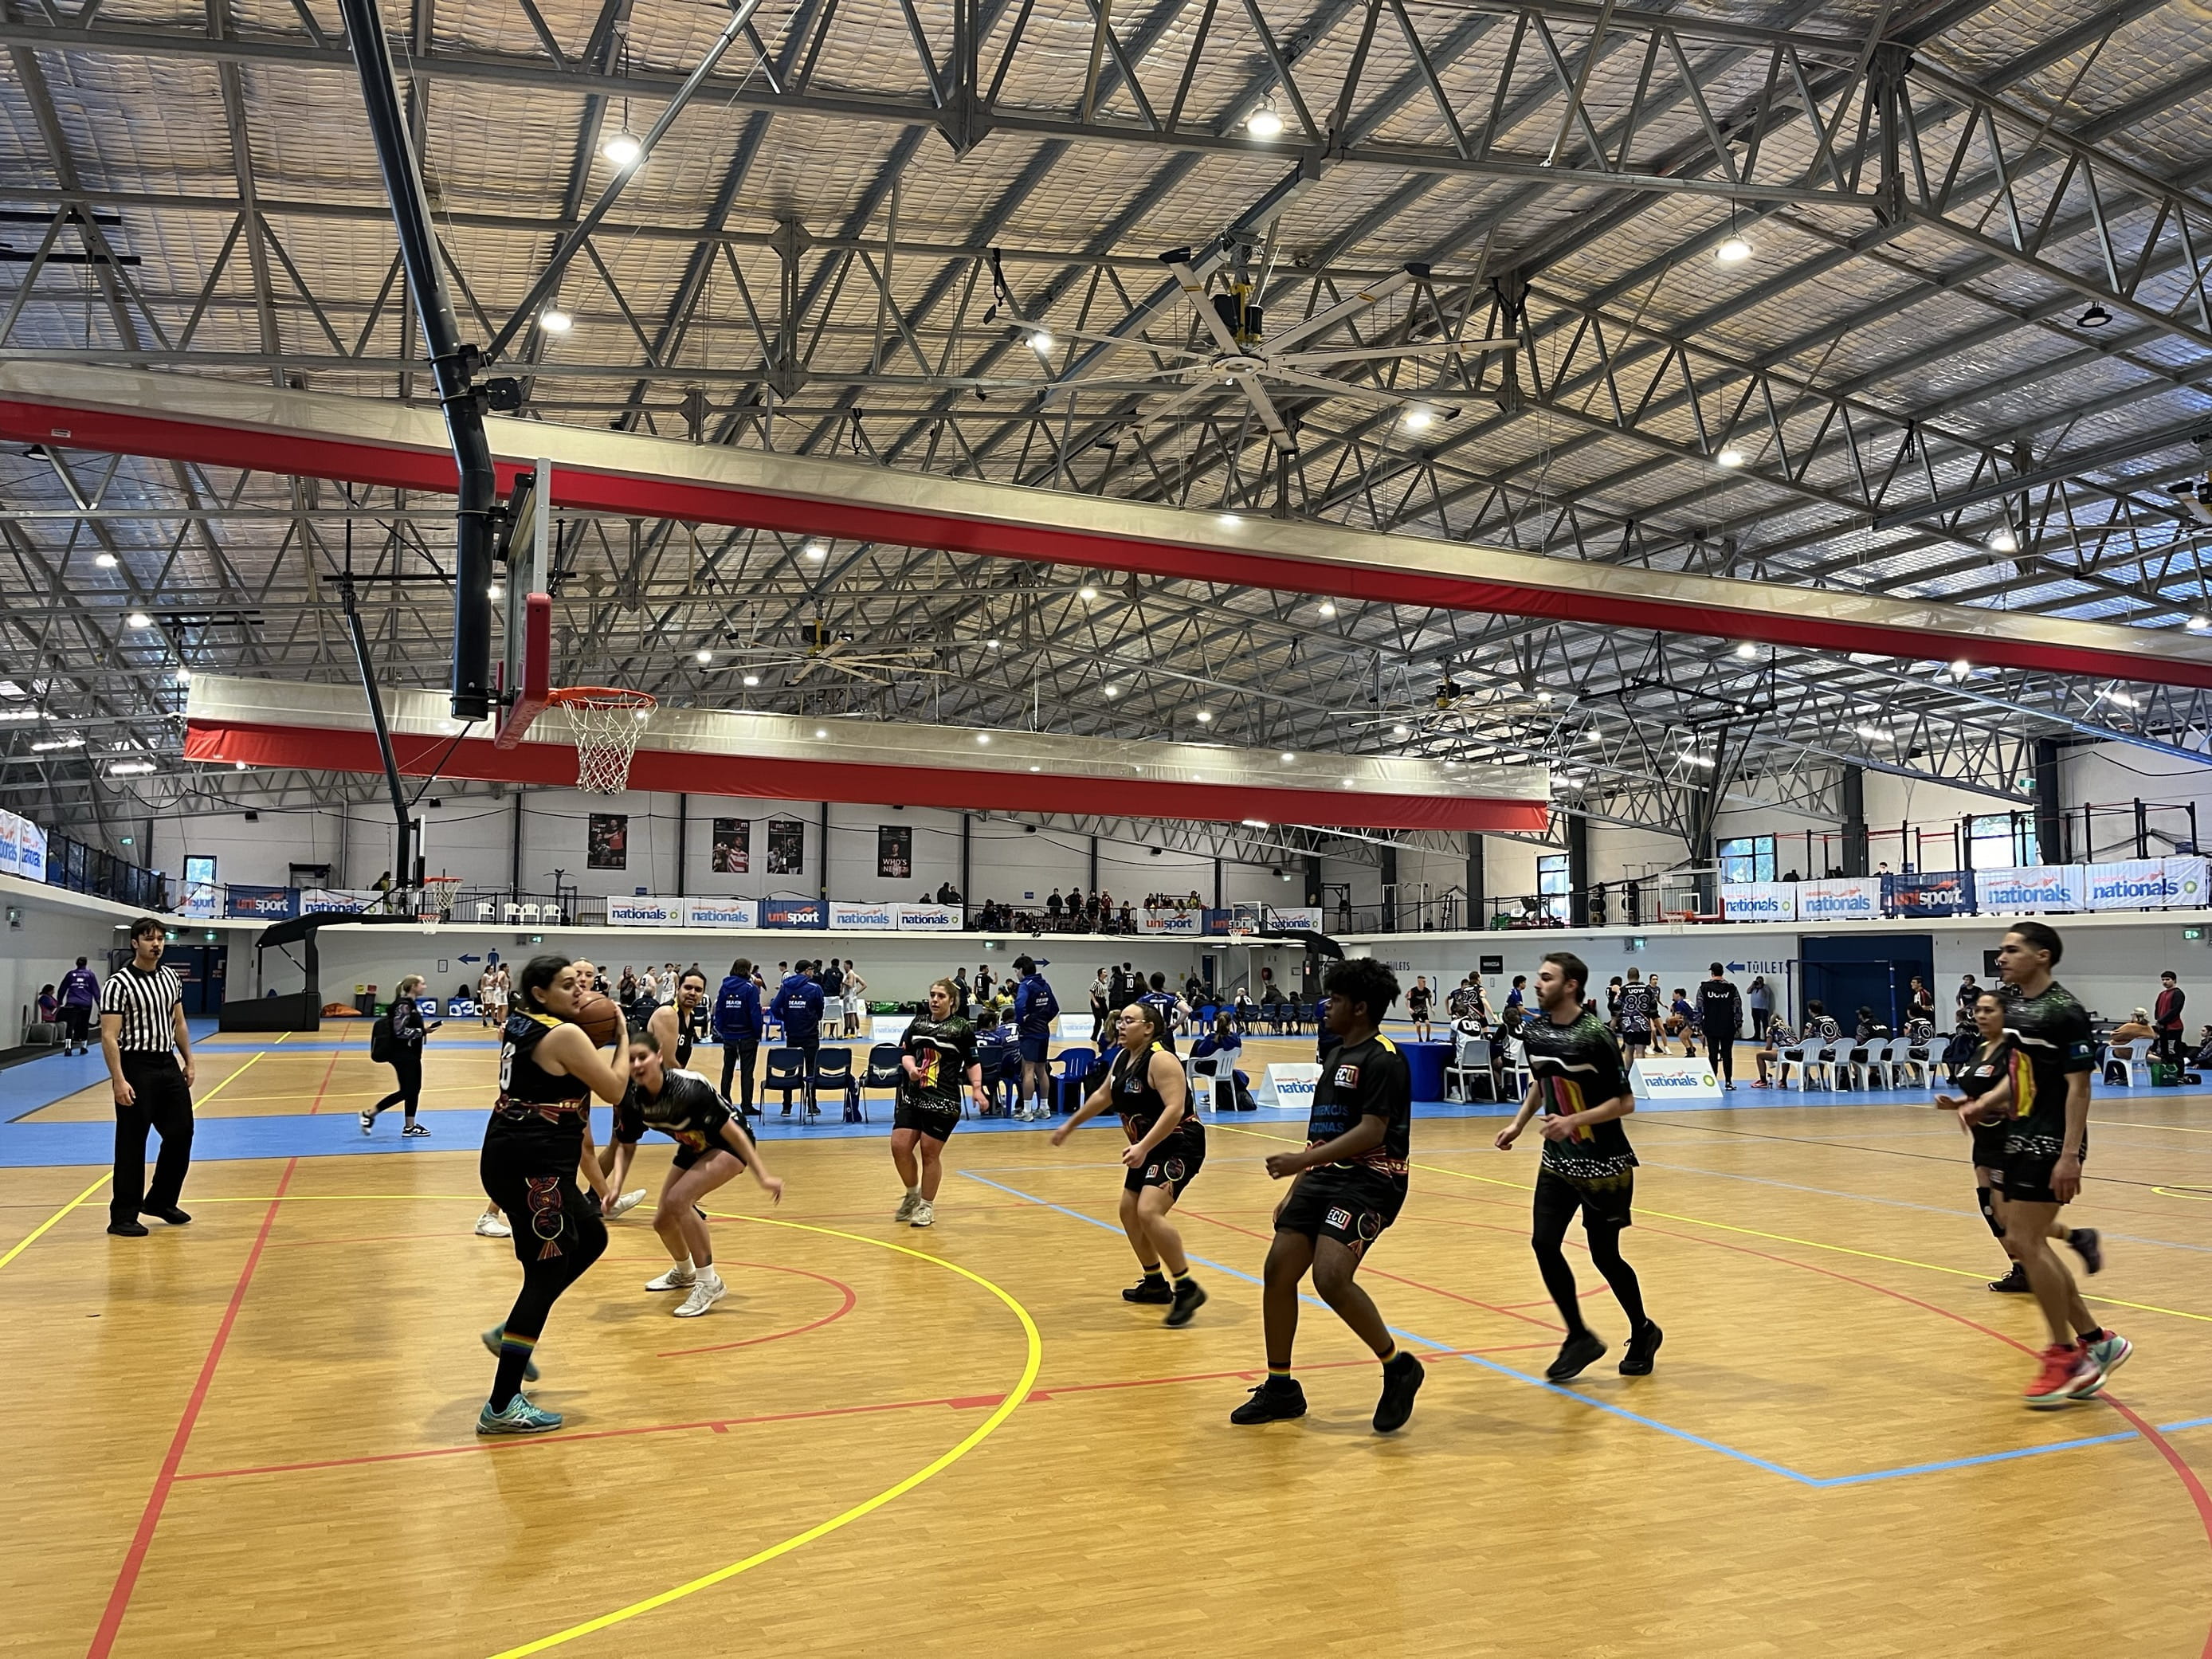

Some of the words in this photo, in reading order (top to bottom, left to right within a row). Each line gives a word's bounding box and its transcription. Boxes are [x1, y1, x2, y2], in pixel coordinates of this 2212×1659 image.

[1988, 884, 2071, 904] nationals
[2093, 878, 2179, 899] nationals
[236, 897, 289, 913] unisport
[1726, 897, 1778, 912] nationals
[1806, 894, 1870, 912] nationals
[612, 908, 666, 920] nationals
[692, 909, 748, 923] nationals
[767, 911, 819, 924] unisport
[837, 912, 889, 924] nationals
[901, 914, 948, 924] nationals
[1146, 918, 1192, 929] unisport
[1626, 994, 1649, 1012] 88
[1335, 1068, 1355, 1082] ECU
[1645, 1075, 1698, 1087] nationals
[1277, 1081, 1317, 1093] nation
[1327, 1209, 1347, 1224] ECU
